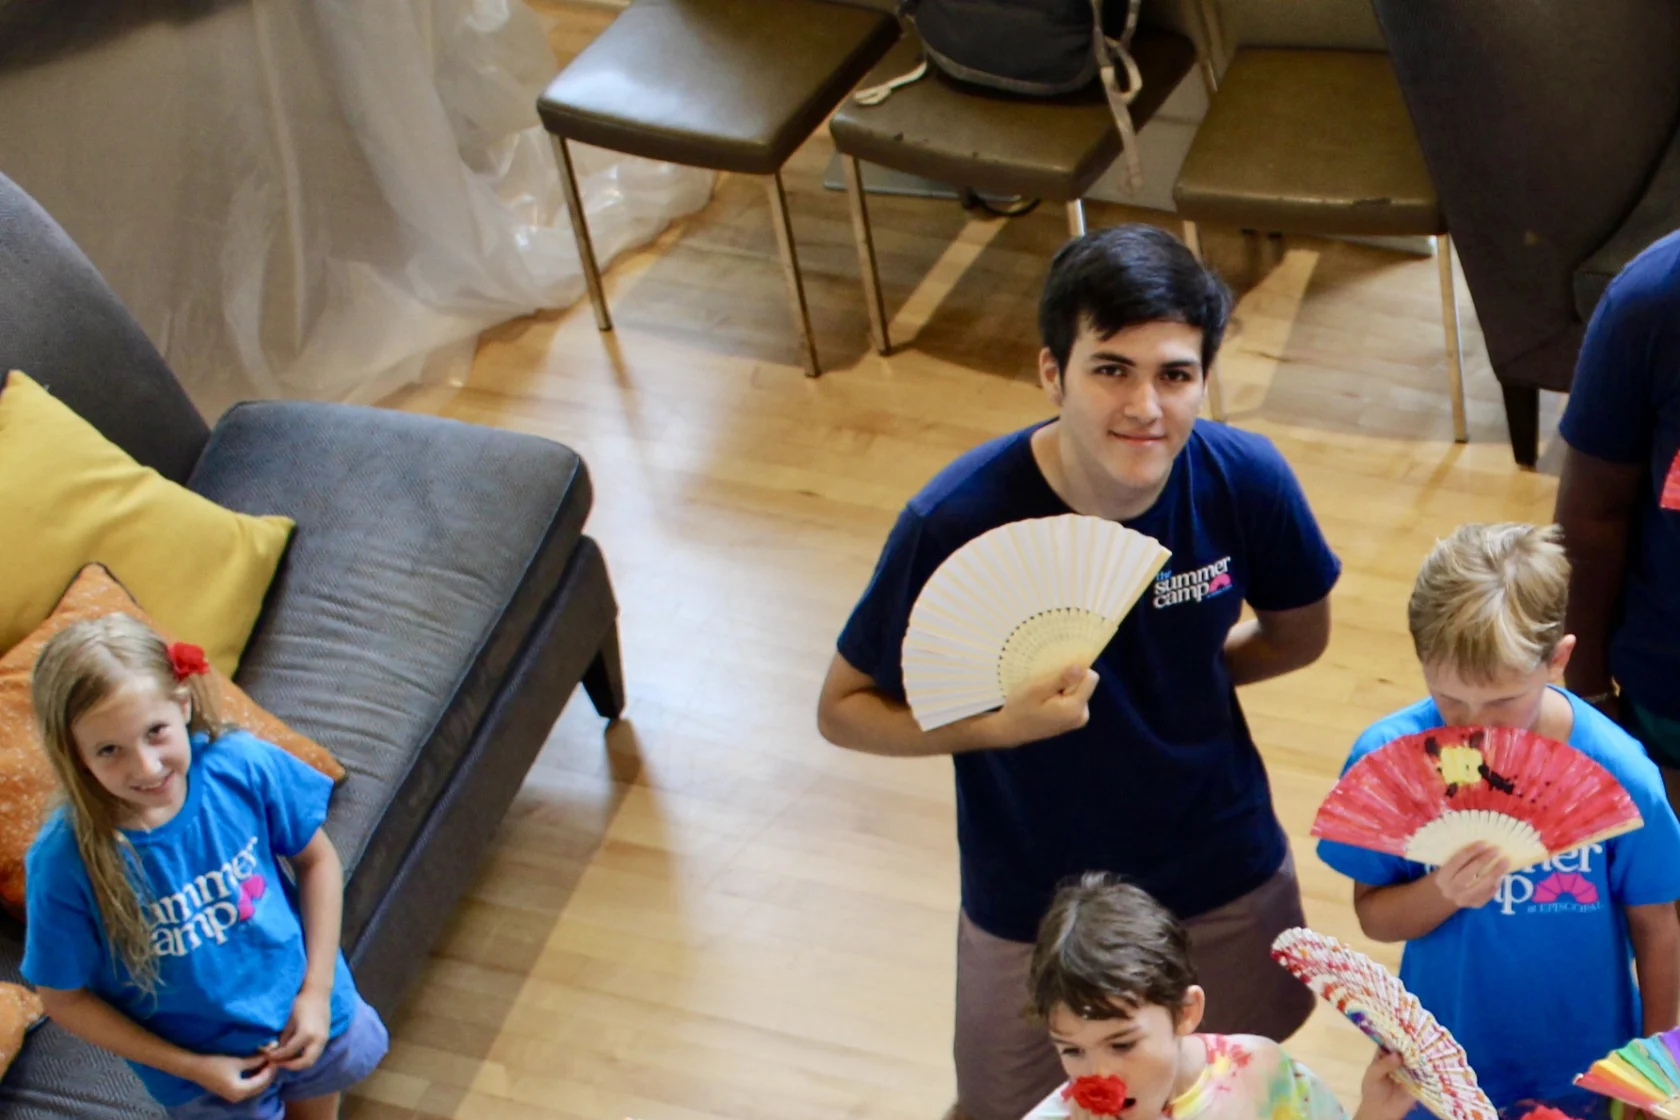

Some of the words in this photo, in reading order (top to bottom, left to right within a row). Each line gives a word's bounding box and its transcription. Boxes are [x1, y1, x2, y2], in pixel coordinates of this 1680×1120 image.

[1155, 556, 1231, 595] summer
[1153, 582, 1210, 609] camp
[150, 901, 238, 957] amp
